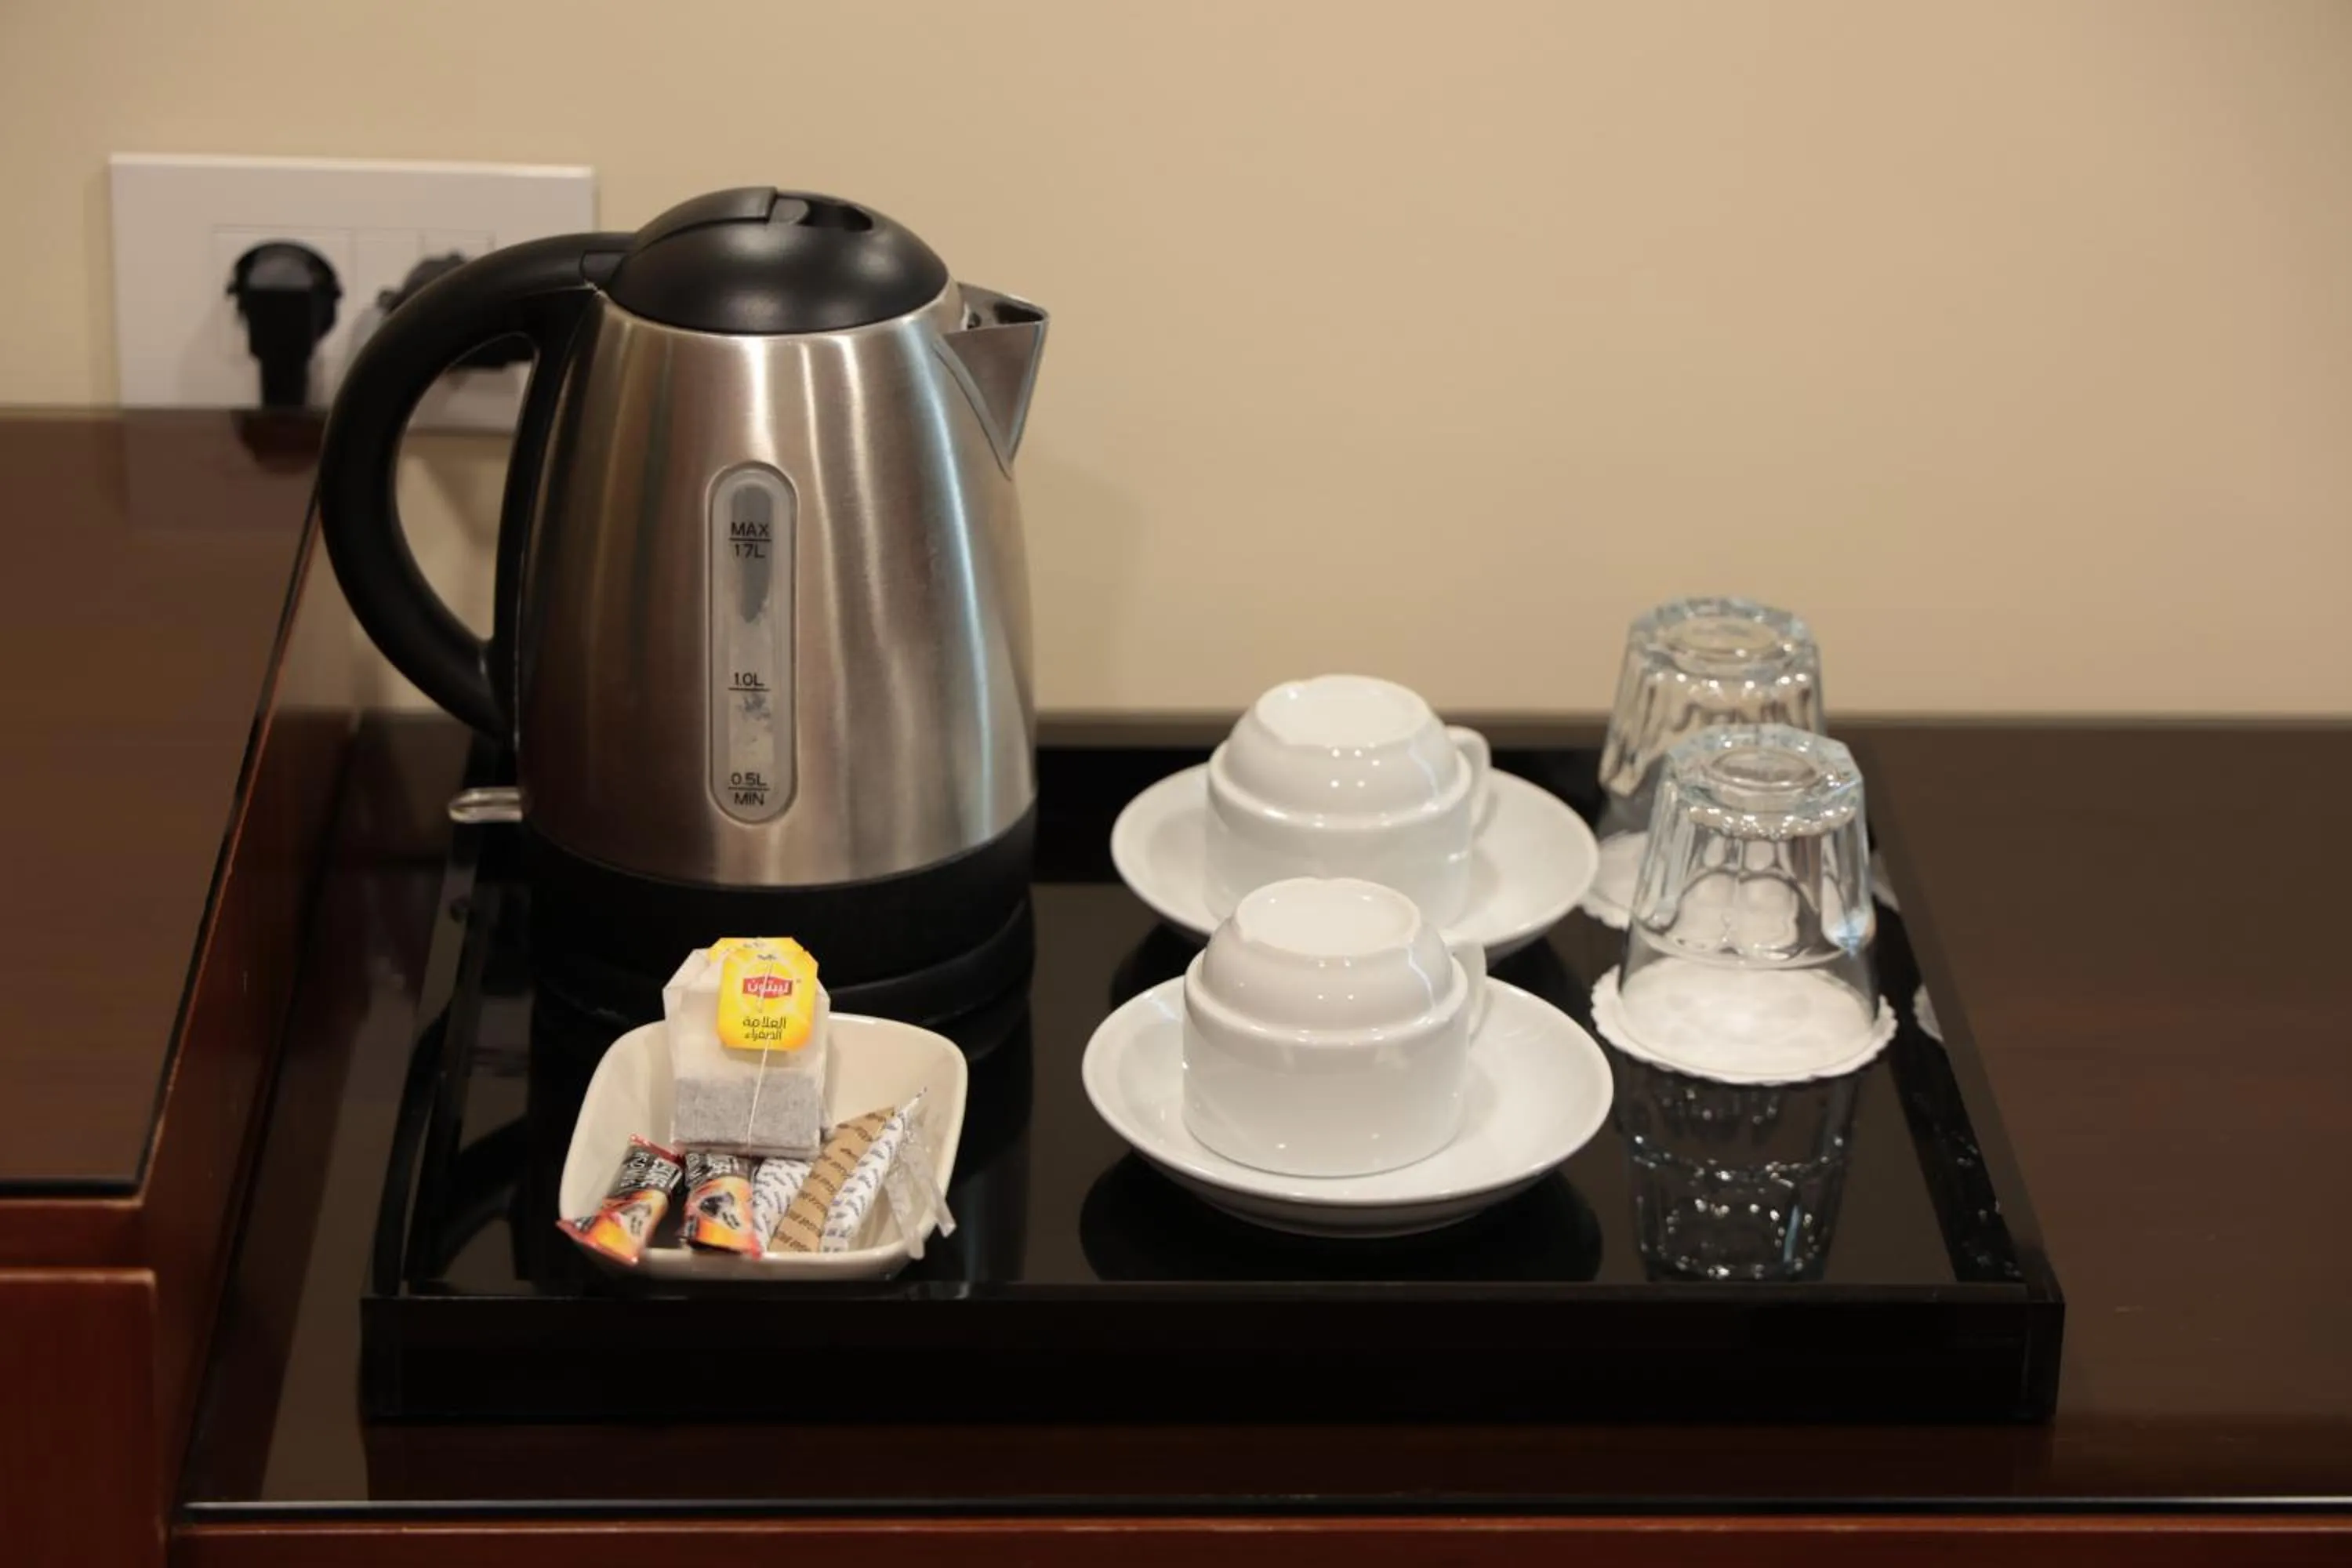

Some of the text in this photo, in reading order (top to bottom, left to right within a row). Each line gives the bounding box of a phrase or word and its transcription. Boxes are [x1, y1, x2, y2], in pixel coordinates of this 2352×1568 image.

[731, 521, 769, 537] MAX
[734, 791, 765, 806] MIN
[742, 1015, 787, 1029] العلامة
